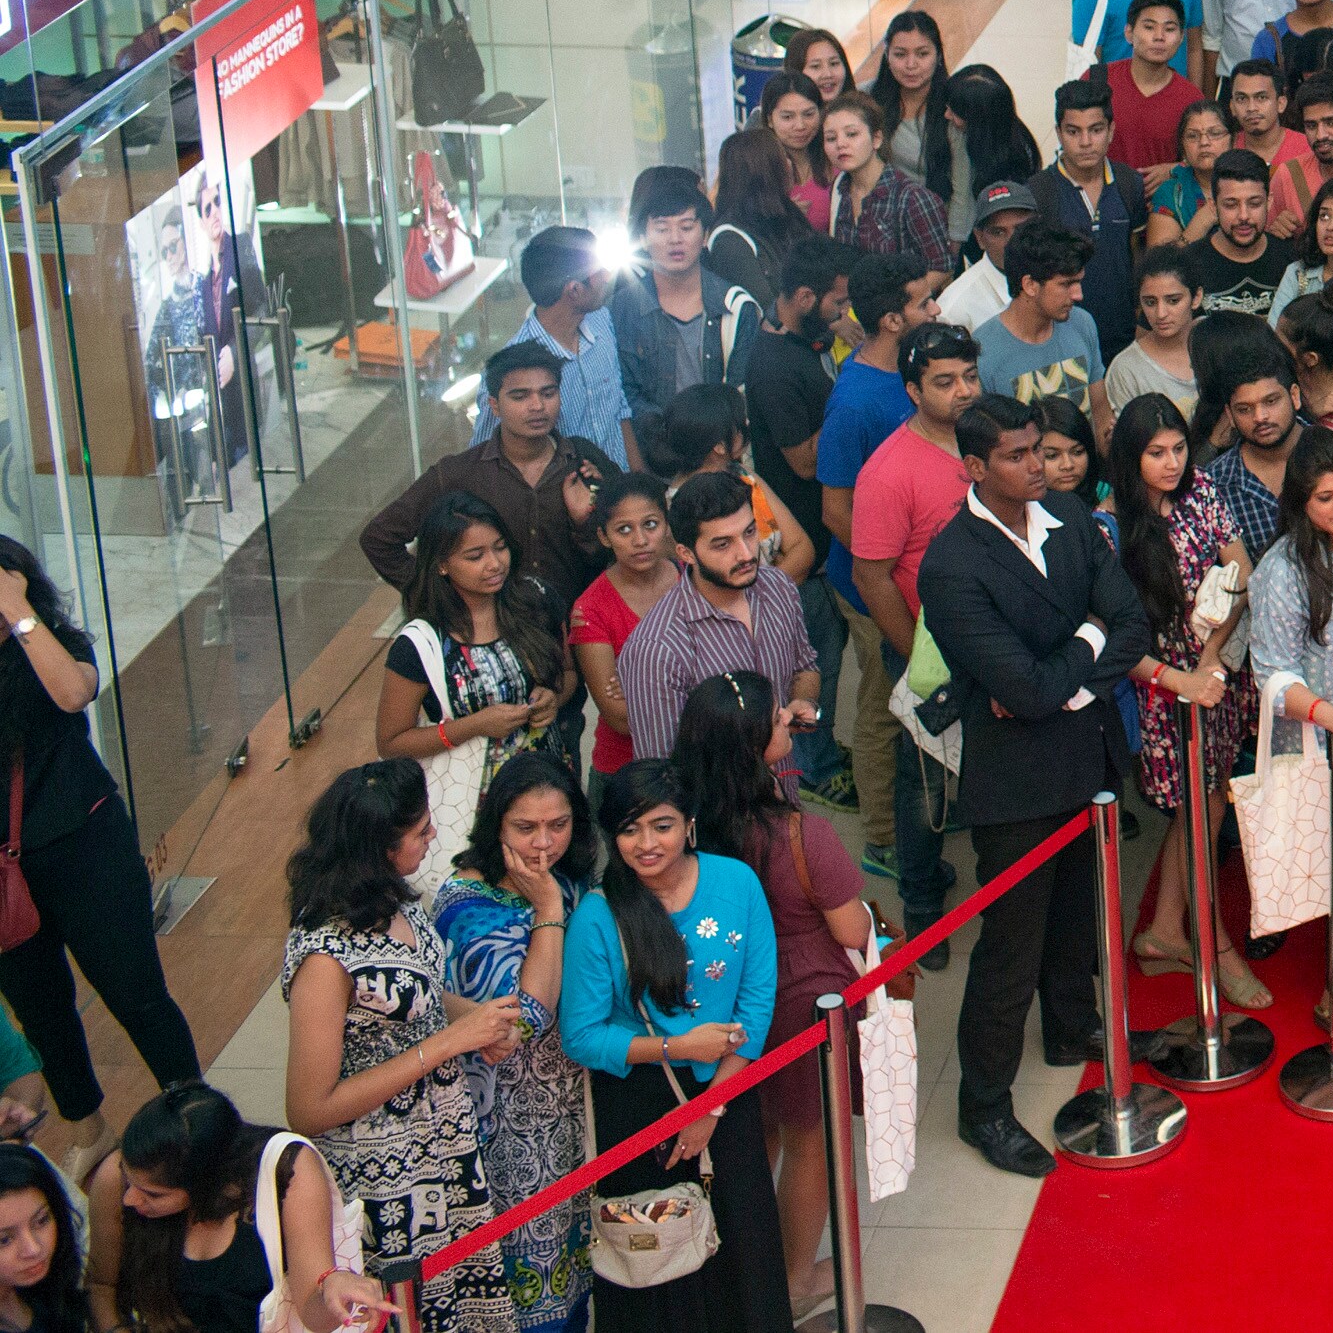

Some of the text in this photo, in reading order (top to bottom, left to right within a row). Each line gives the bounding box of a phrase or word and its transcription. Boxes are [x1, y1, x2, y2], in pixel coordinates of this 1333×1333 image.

[218, 22, 305, 100] FASHION STORE?
[229, 16, 285, 71] MANNEQUINS
[285, 9, 295, 28] IN
[295, 5, 303, 21] A
